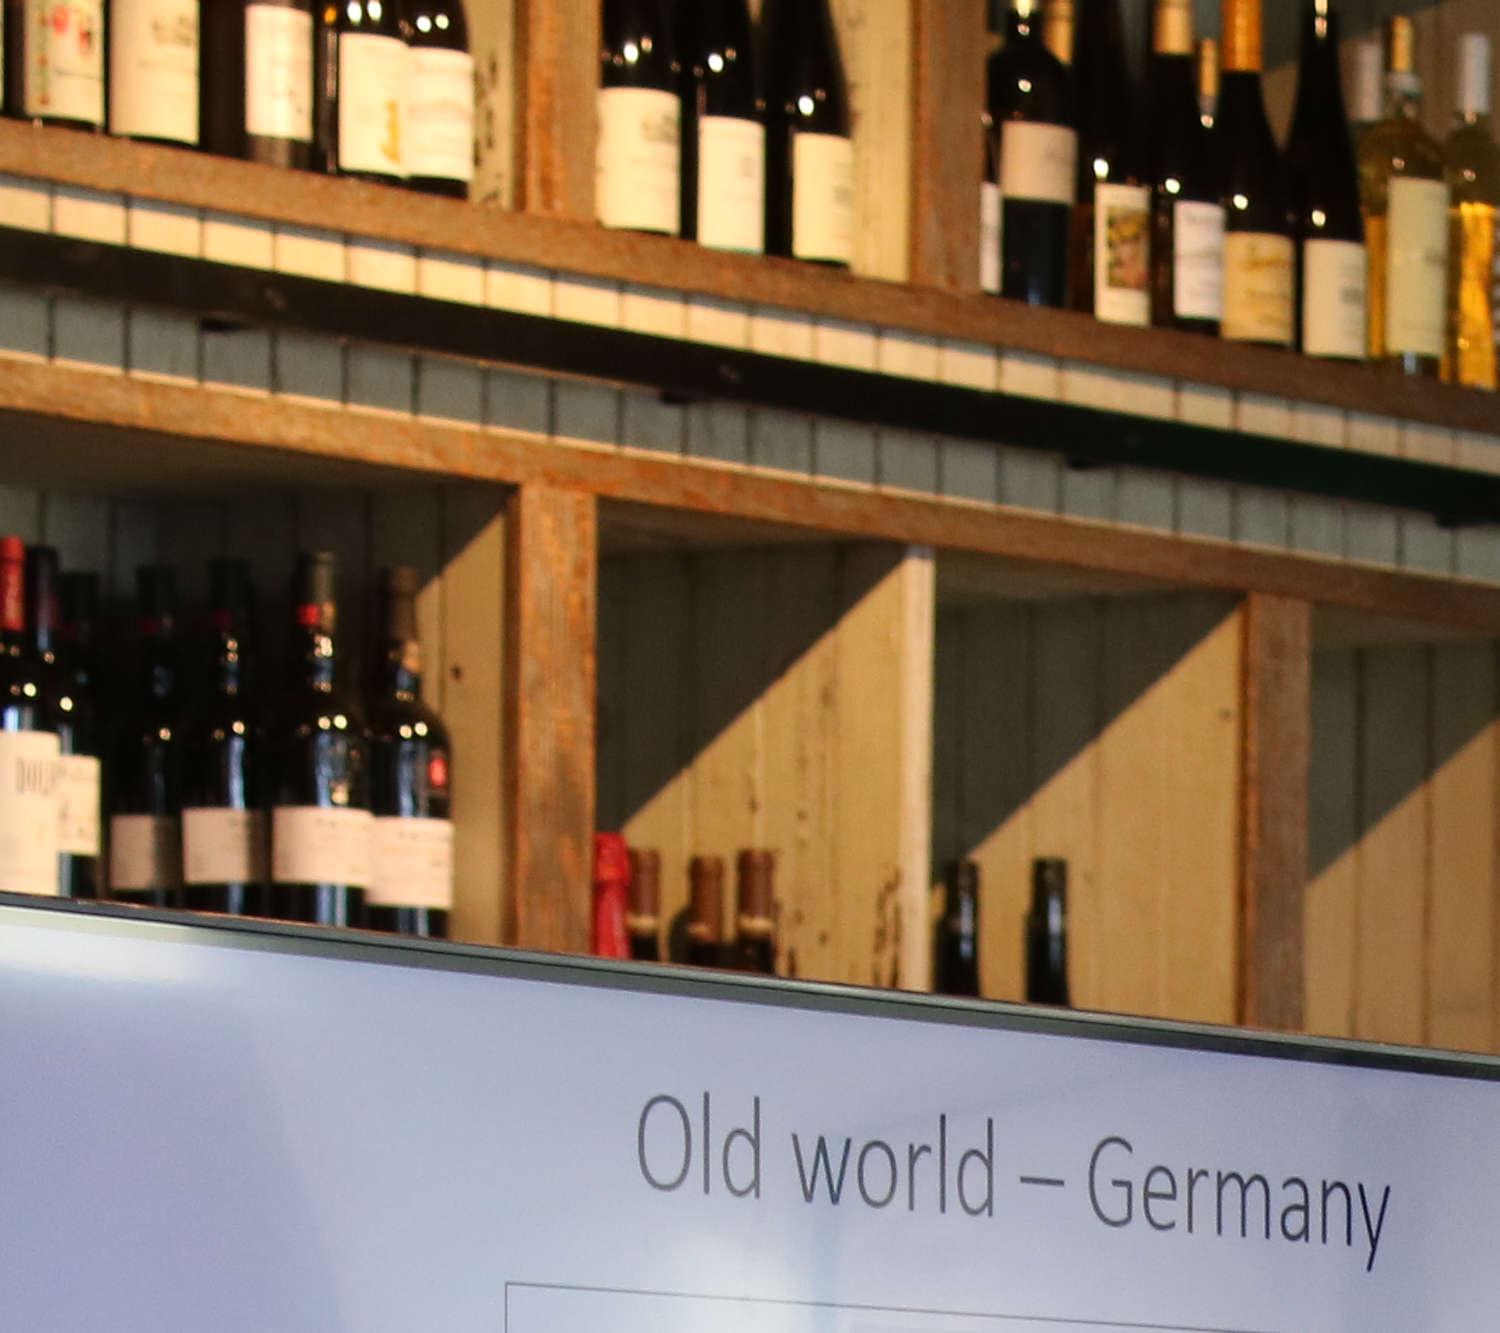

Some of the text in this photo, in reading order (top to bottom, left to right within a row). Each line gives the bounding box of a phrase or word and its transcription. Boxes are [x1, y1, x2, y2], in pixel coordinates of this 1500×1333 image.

[638, 1091, 760, 1199] Old
[791, 1114, 994, 1217] world
[1088, 1136, 1390, 1272] Germany
